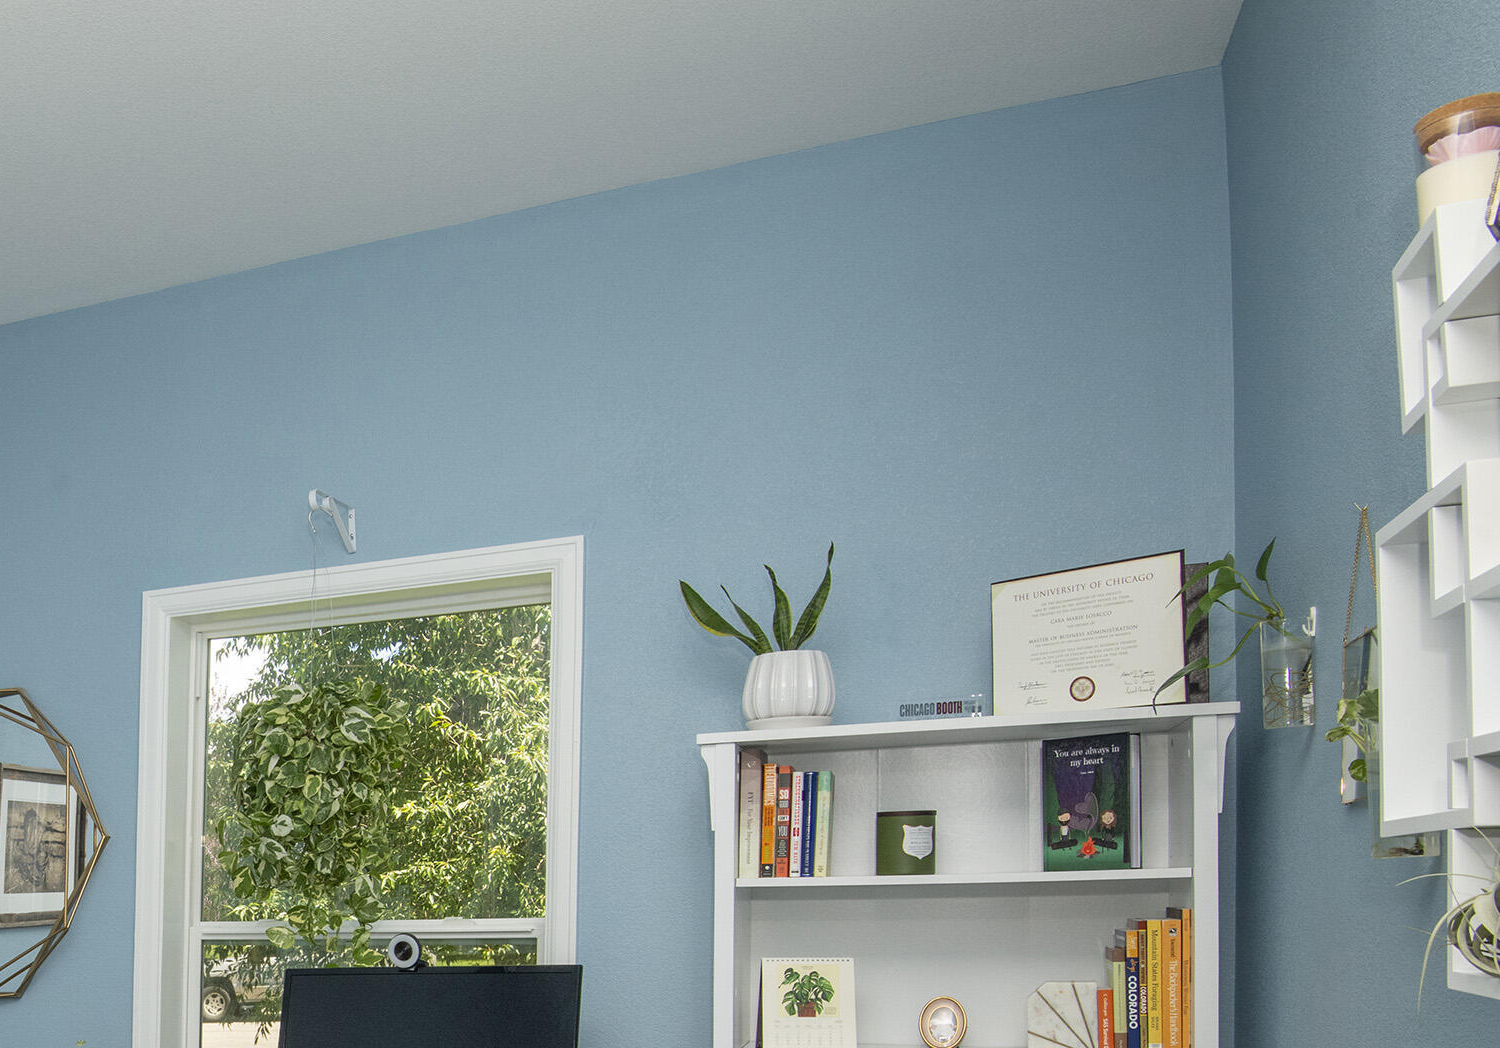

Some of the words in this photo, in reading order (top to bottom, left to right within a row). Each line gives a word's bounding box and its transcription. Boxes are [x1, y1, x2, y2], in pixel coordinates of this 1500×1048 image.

[1013, 593, 1029, 602] THE
[1033, 584, 1086, 598] UNIVERSITY
[1090, 581, 1101, 589] OF
[1106, 573, 1154, 586] CHICAGO
[900, 703, 935, 717] CHICAGO
[936, 701, 962, 715] BOOTH
[1085, 747, 1109, 755] always
[1112, 744, 1119, 752] in
[1070, 760, 1081, 768] my
[1084, 757, 1103, 765] heart
[1152, 962, 1160, 981] States
[1127, 975, 1138, 1029] COLORADO
[1151, 983, 1160, 1011] Foraging
